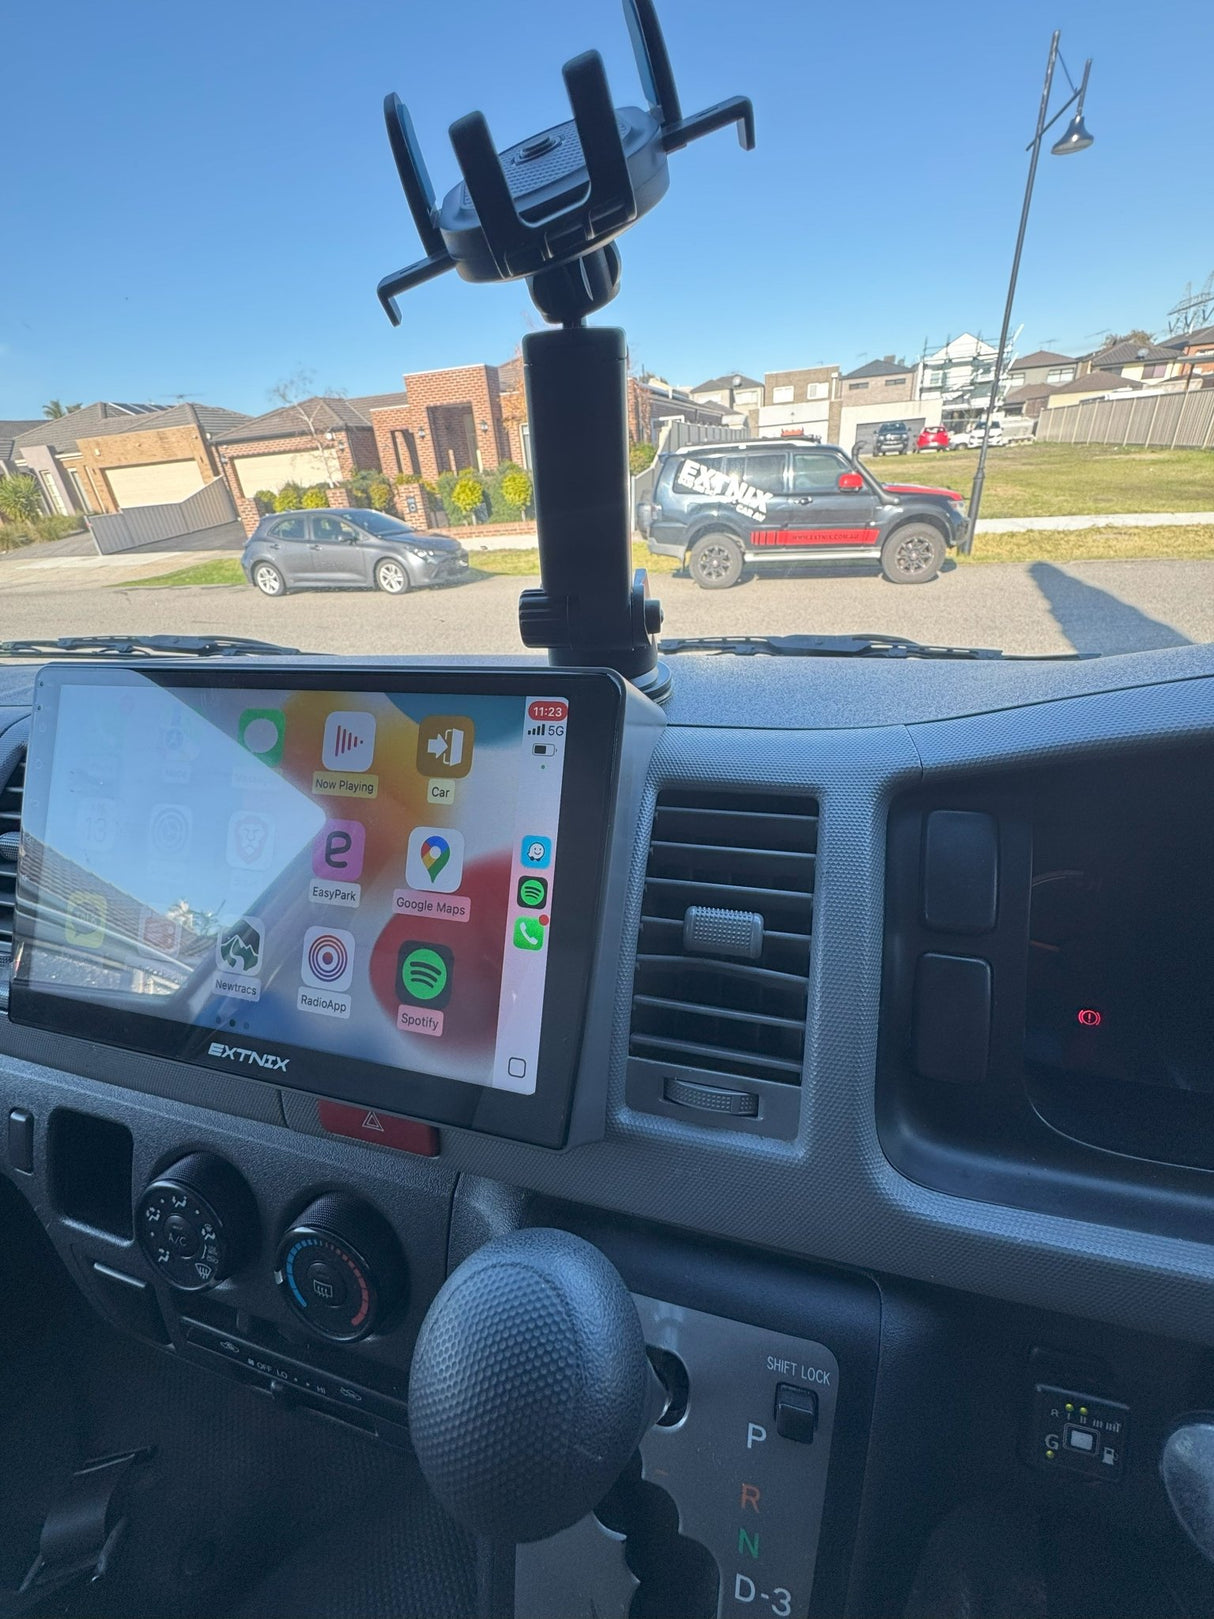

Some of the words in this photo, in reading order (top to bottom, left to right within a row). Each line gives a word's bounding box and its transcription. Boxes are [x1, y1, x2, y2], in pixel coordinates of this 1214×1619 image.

[679, 459, 773, 513] EXTNIX
[533, 706, 563, 717] 11:23
[548, 725, 565, 736] 5G
[315, 778, 337, 790] Now
[339, 780, 374, 794] Playing
[431, 786, 450, 798] Car
[312, 886, 356, 902] EasyPark
[396, 897, 433, 913] Google
[436, 902, 466, 916] Maps
[215, 978, 257, 996] Newtracs
[300, 994, 347, 1013] RadioApp
[401, 1013, 440, 1031] Spotify
[208, 1042, 290, 1072] EXTNIX
[168, 1232, 187, 1247] A/C
[256, 1361, 273, 1372] OFF
[276, 1369, 288, 1379] LO
[767, 1356, 798, 1377] SHIFT
[801, 1365, 831, 1386] LOCK
[747, 1422, 767, 1448] P
[1044, 1433, 1059, 1450] G
[741, 1483, 761, 1514] R
[738, 1528, 760, 1559] N
[734, 1573, 792, 1617] D-3
